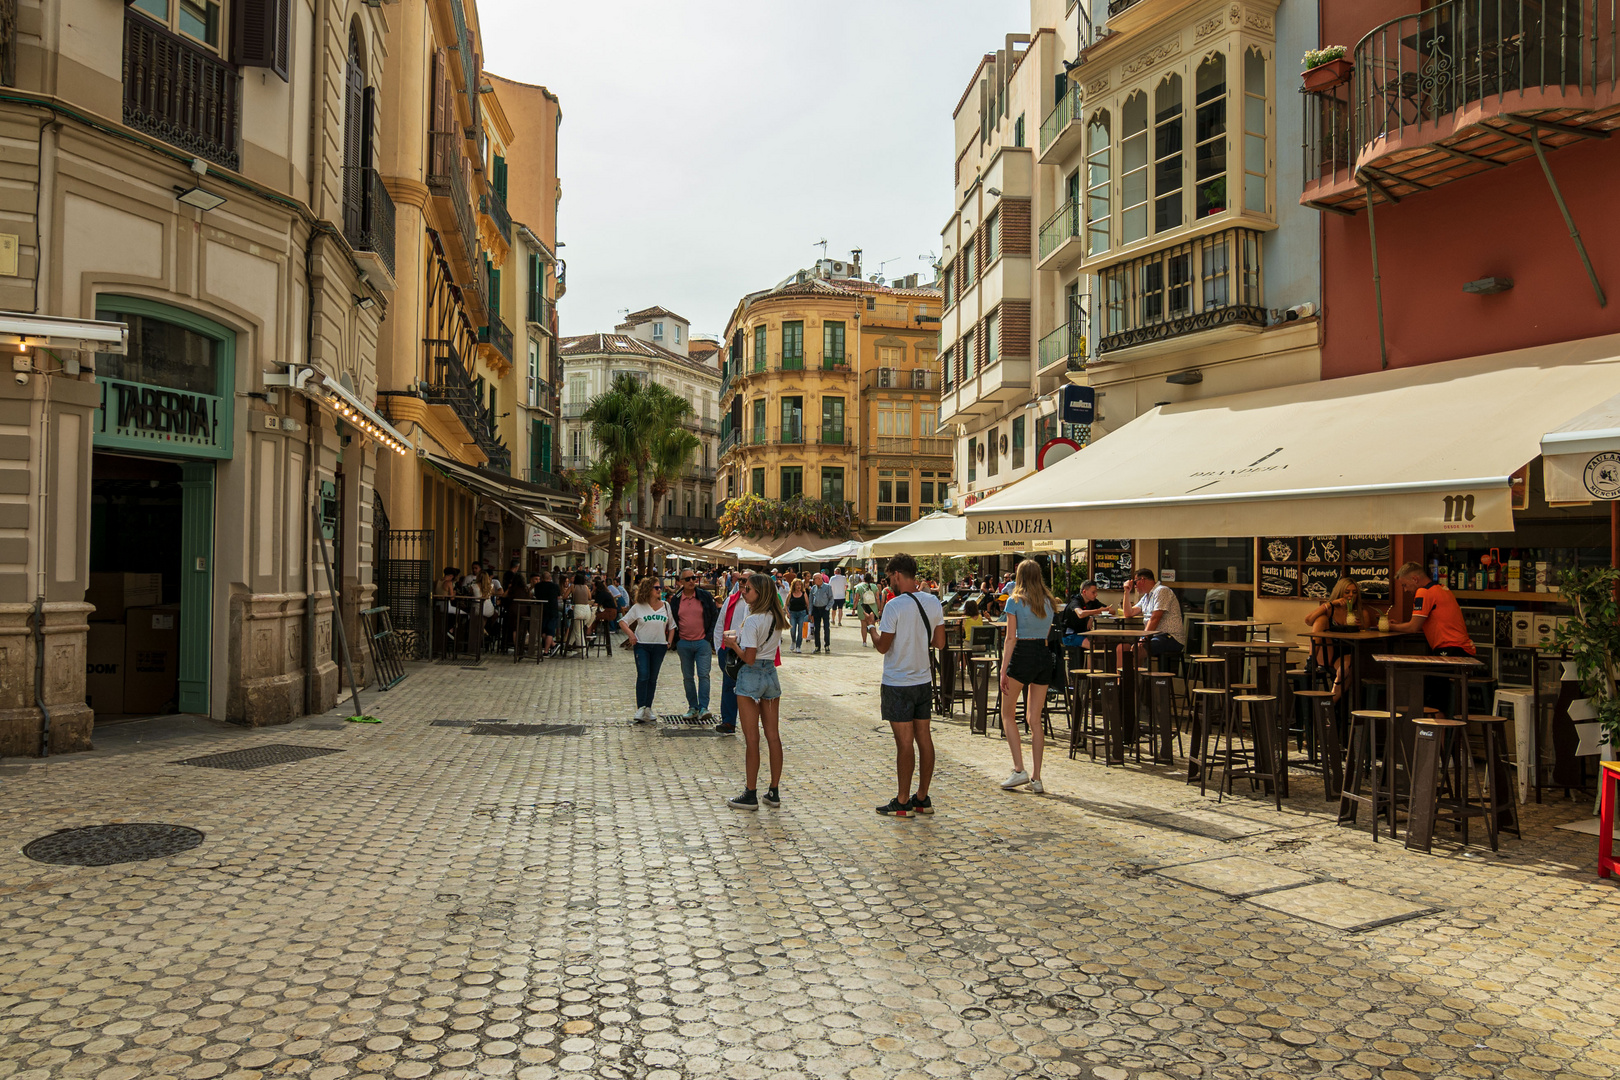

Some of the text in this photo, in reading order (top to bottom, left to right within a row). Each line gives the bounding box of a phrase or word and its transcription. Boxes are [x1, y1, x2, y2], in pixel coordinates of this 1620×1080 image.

[112, 383, 210, 437] TABERNA
[268, 417, 276, 427] 30
[117, 428, 163, 439] PLATOS
[174, 435, 209, 445] COPAS
